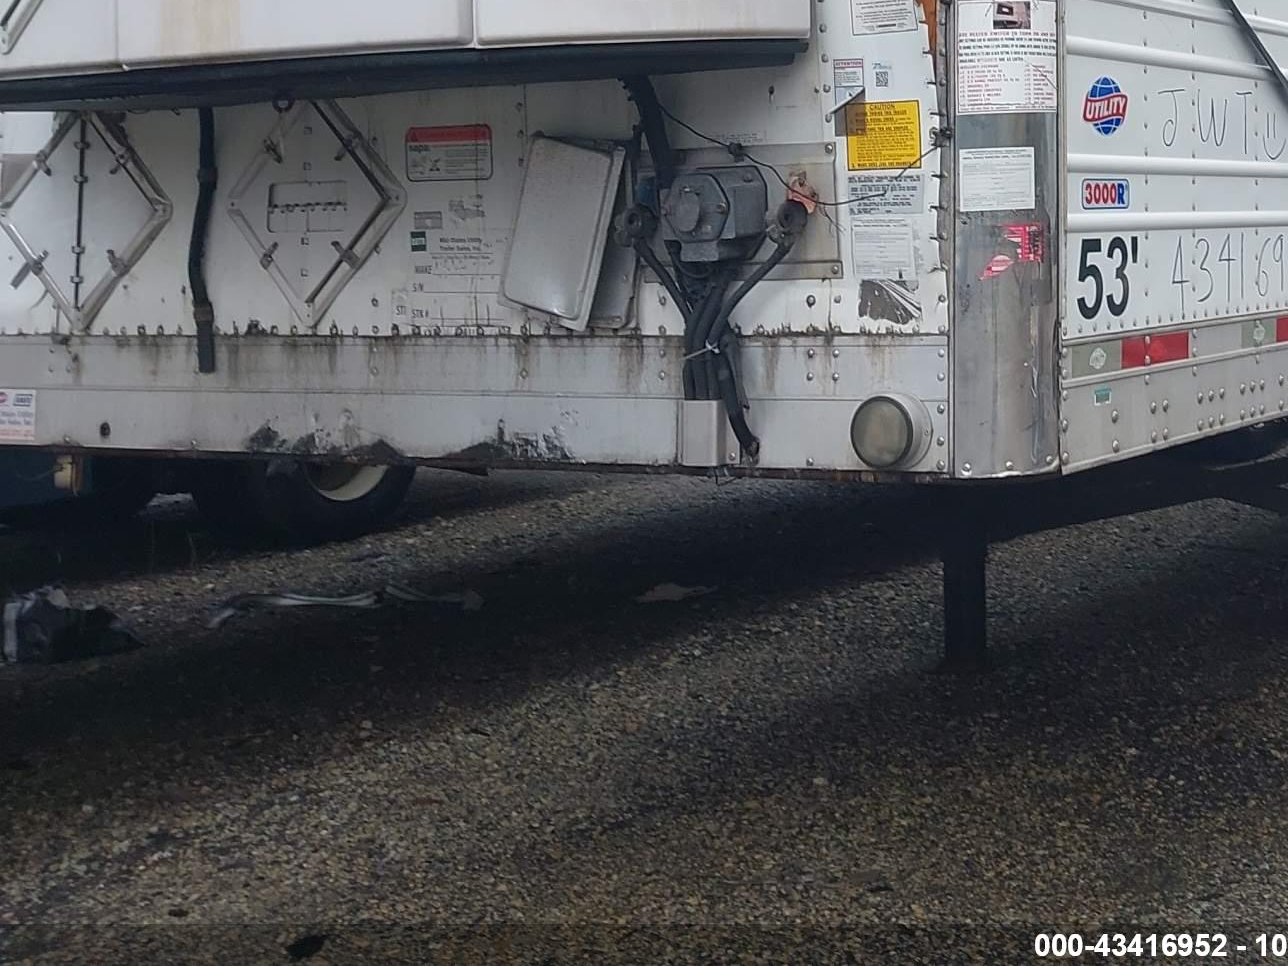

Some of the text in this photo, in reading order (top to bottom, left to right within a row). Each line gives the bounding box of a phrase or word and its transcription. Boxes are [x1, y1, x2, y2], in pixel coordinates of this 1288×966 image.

[1085, 97, 1127, 119] UTILITY
[1084, 183, 1127, 205] 3000R
[1077, 236, 1138, 320] 53'
